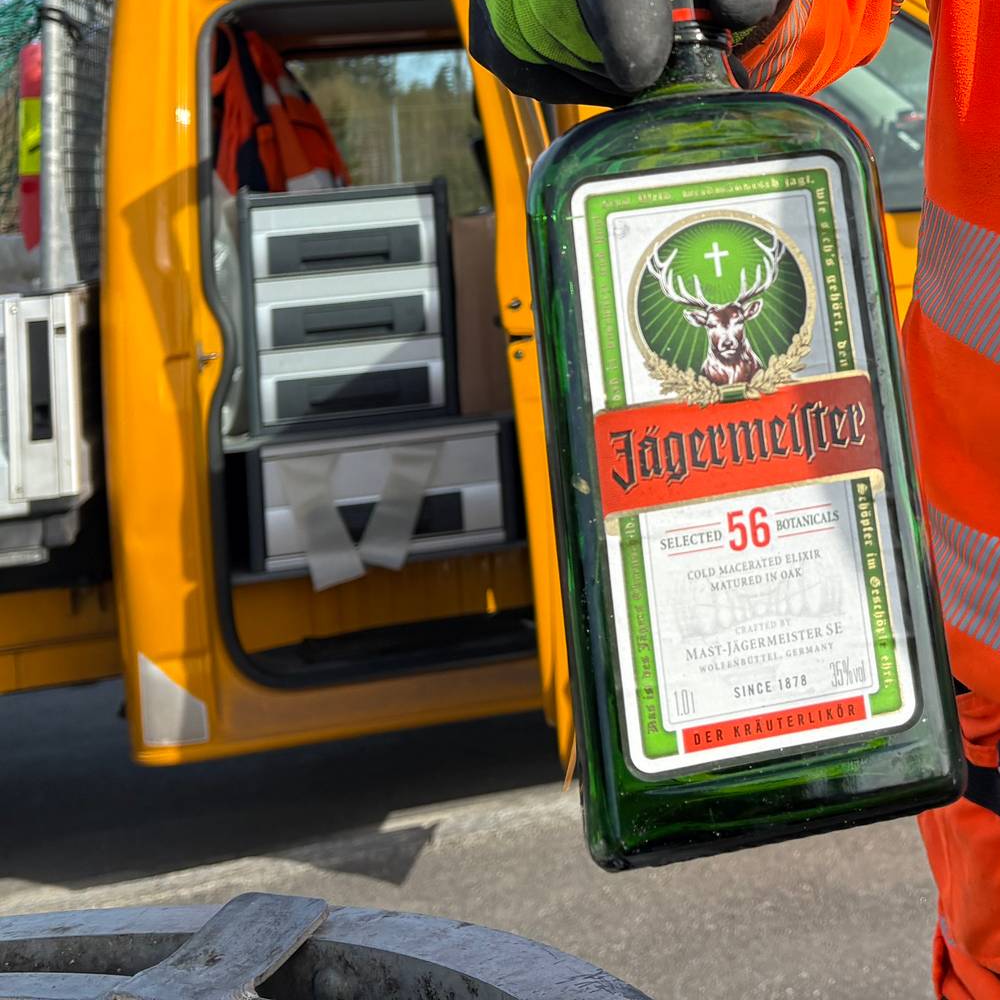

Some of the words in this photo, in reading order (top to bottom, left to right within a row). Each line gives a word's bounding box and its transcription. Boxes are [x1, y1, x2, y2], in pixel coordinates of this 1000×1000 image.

[610, 401, 866, 494] Jägermeister
[660, 529, 723, 551] SELECTED
[727, 506, 771, 552] 56
[776, 510, 840, 532] BOTANICALS
[687, 567, 716, 581] COLD
[719, 555, 782, 576] MACERATED
[785, 549, 822, 564] ELIXIR
[710, 575, 763, 592] MATURED
[766, 572, 777, 582] IN
[781, 567, 803, 579] OAK
[686, 626, 822, 662] MAST-JÄGERMEISTER
[826, 621, 844, 636] SE
[786, 642, 834, 658] GERMANY
[734, 681, 773, 699] SINCE
[778, 674, 808, 691] 1878
[694, 729, 724, 745] DER
[733, 703, 856, 738] KRÄUTERLIKÖR
